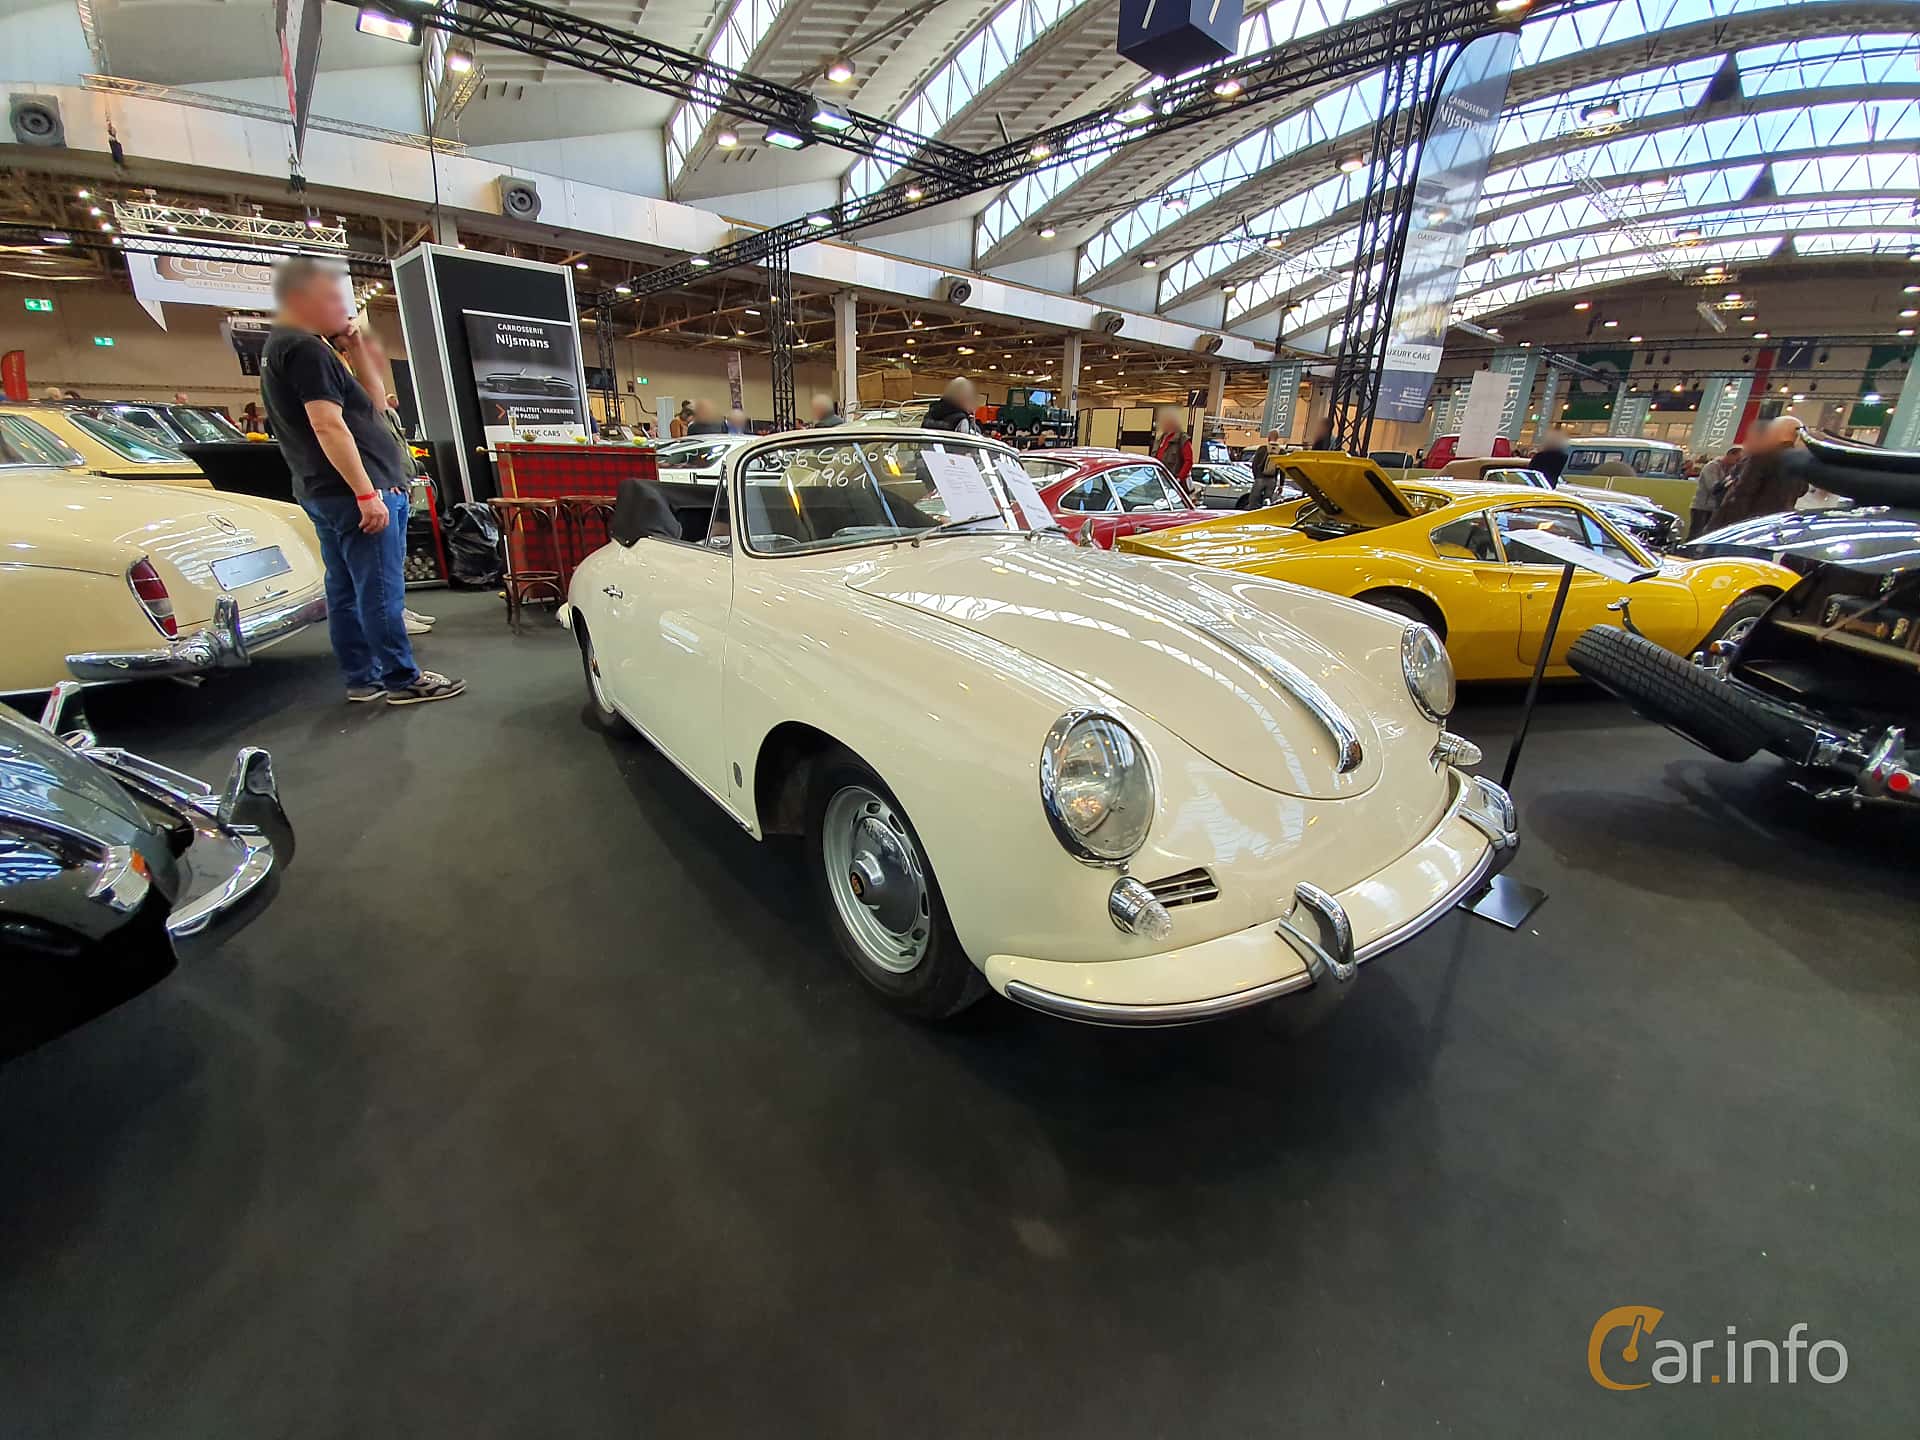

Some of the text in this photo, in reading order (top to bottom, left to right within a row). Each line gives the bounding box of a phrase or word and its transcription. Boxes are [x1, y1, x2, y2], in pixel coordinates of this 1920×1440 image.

[1386, 348, 1431, 361] UXURY CARS
[1190, 389, 1200, 406] 7
[1275, 367, 1296, 432] THIESEN
[1498, 353, 1529, 434] THIESEN
